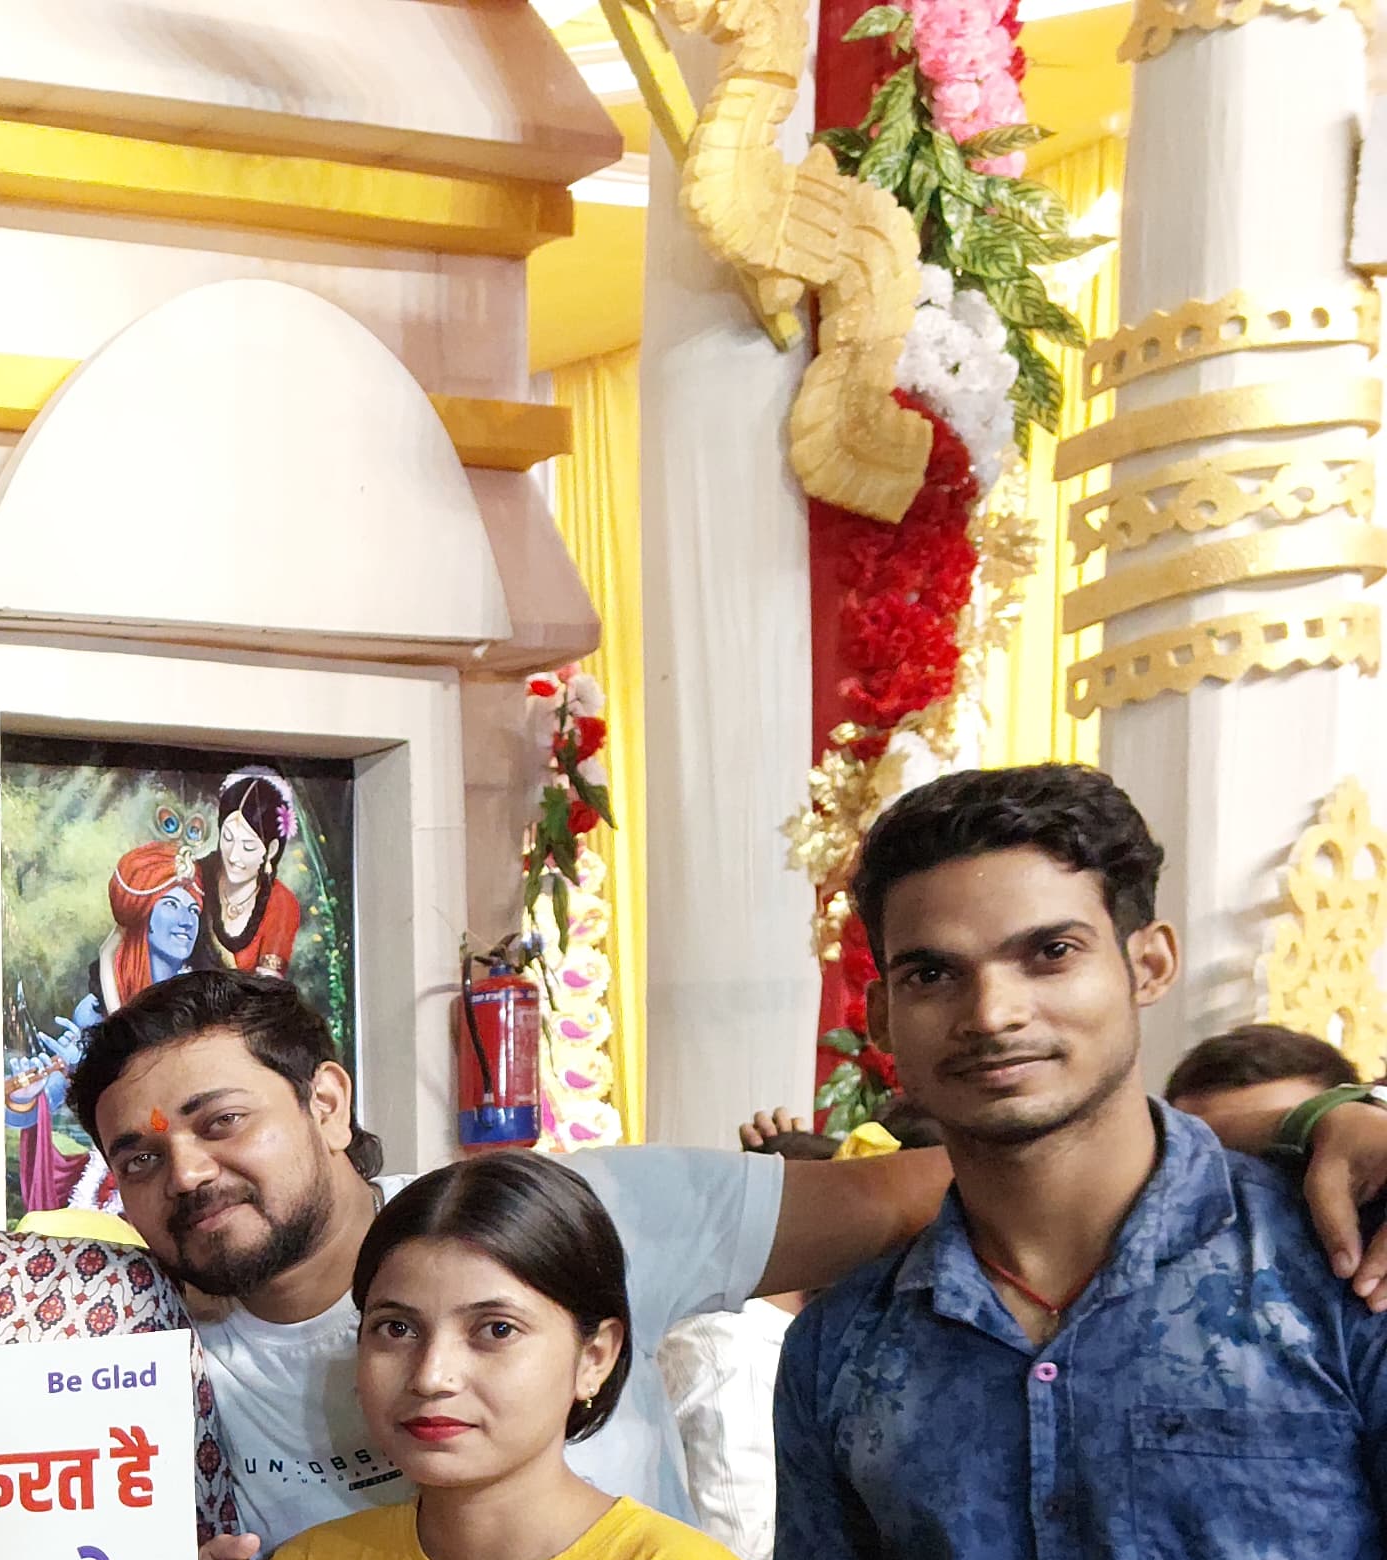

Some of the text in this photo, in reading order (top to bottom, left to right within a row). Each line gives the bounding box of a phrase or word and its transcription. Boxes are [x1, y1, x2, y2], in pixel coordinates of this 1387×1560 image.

[47, 1361, 158, 1394] Be Glad
[109, 1425, 159, 1508] है
